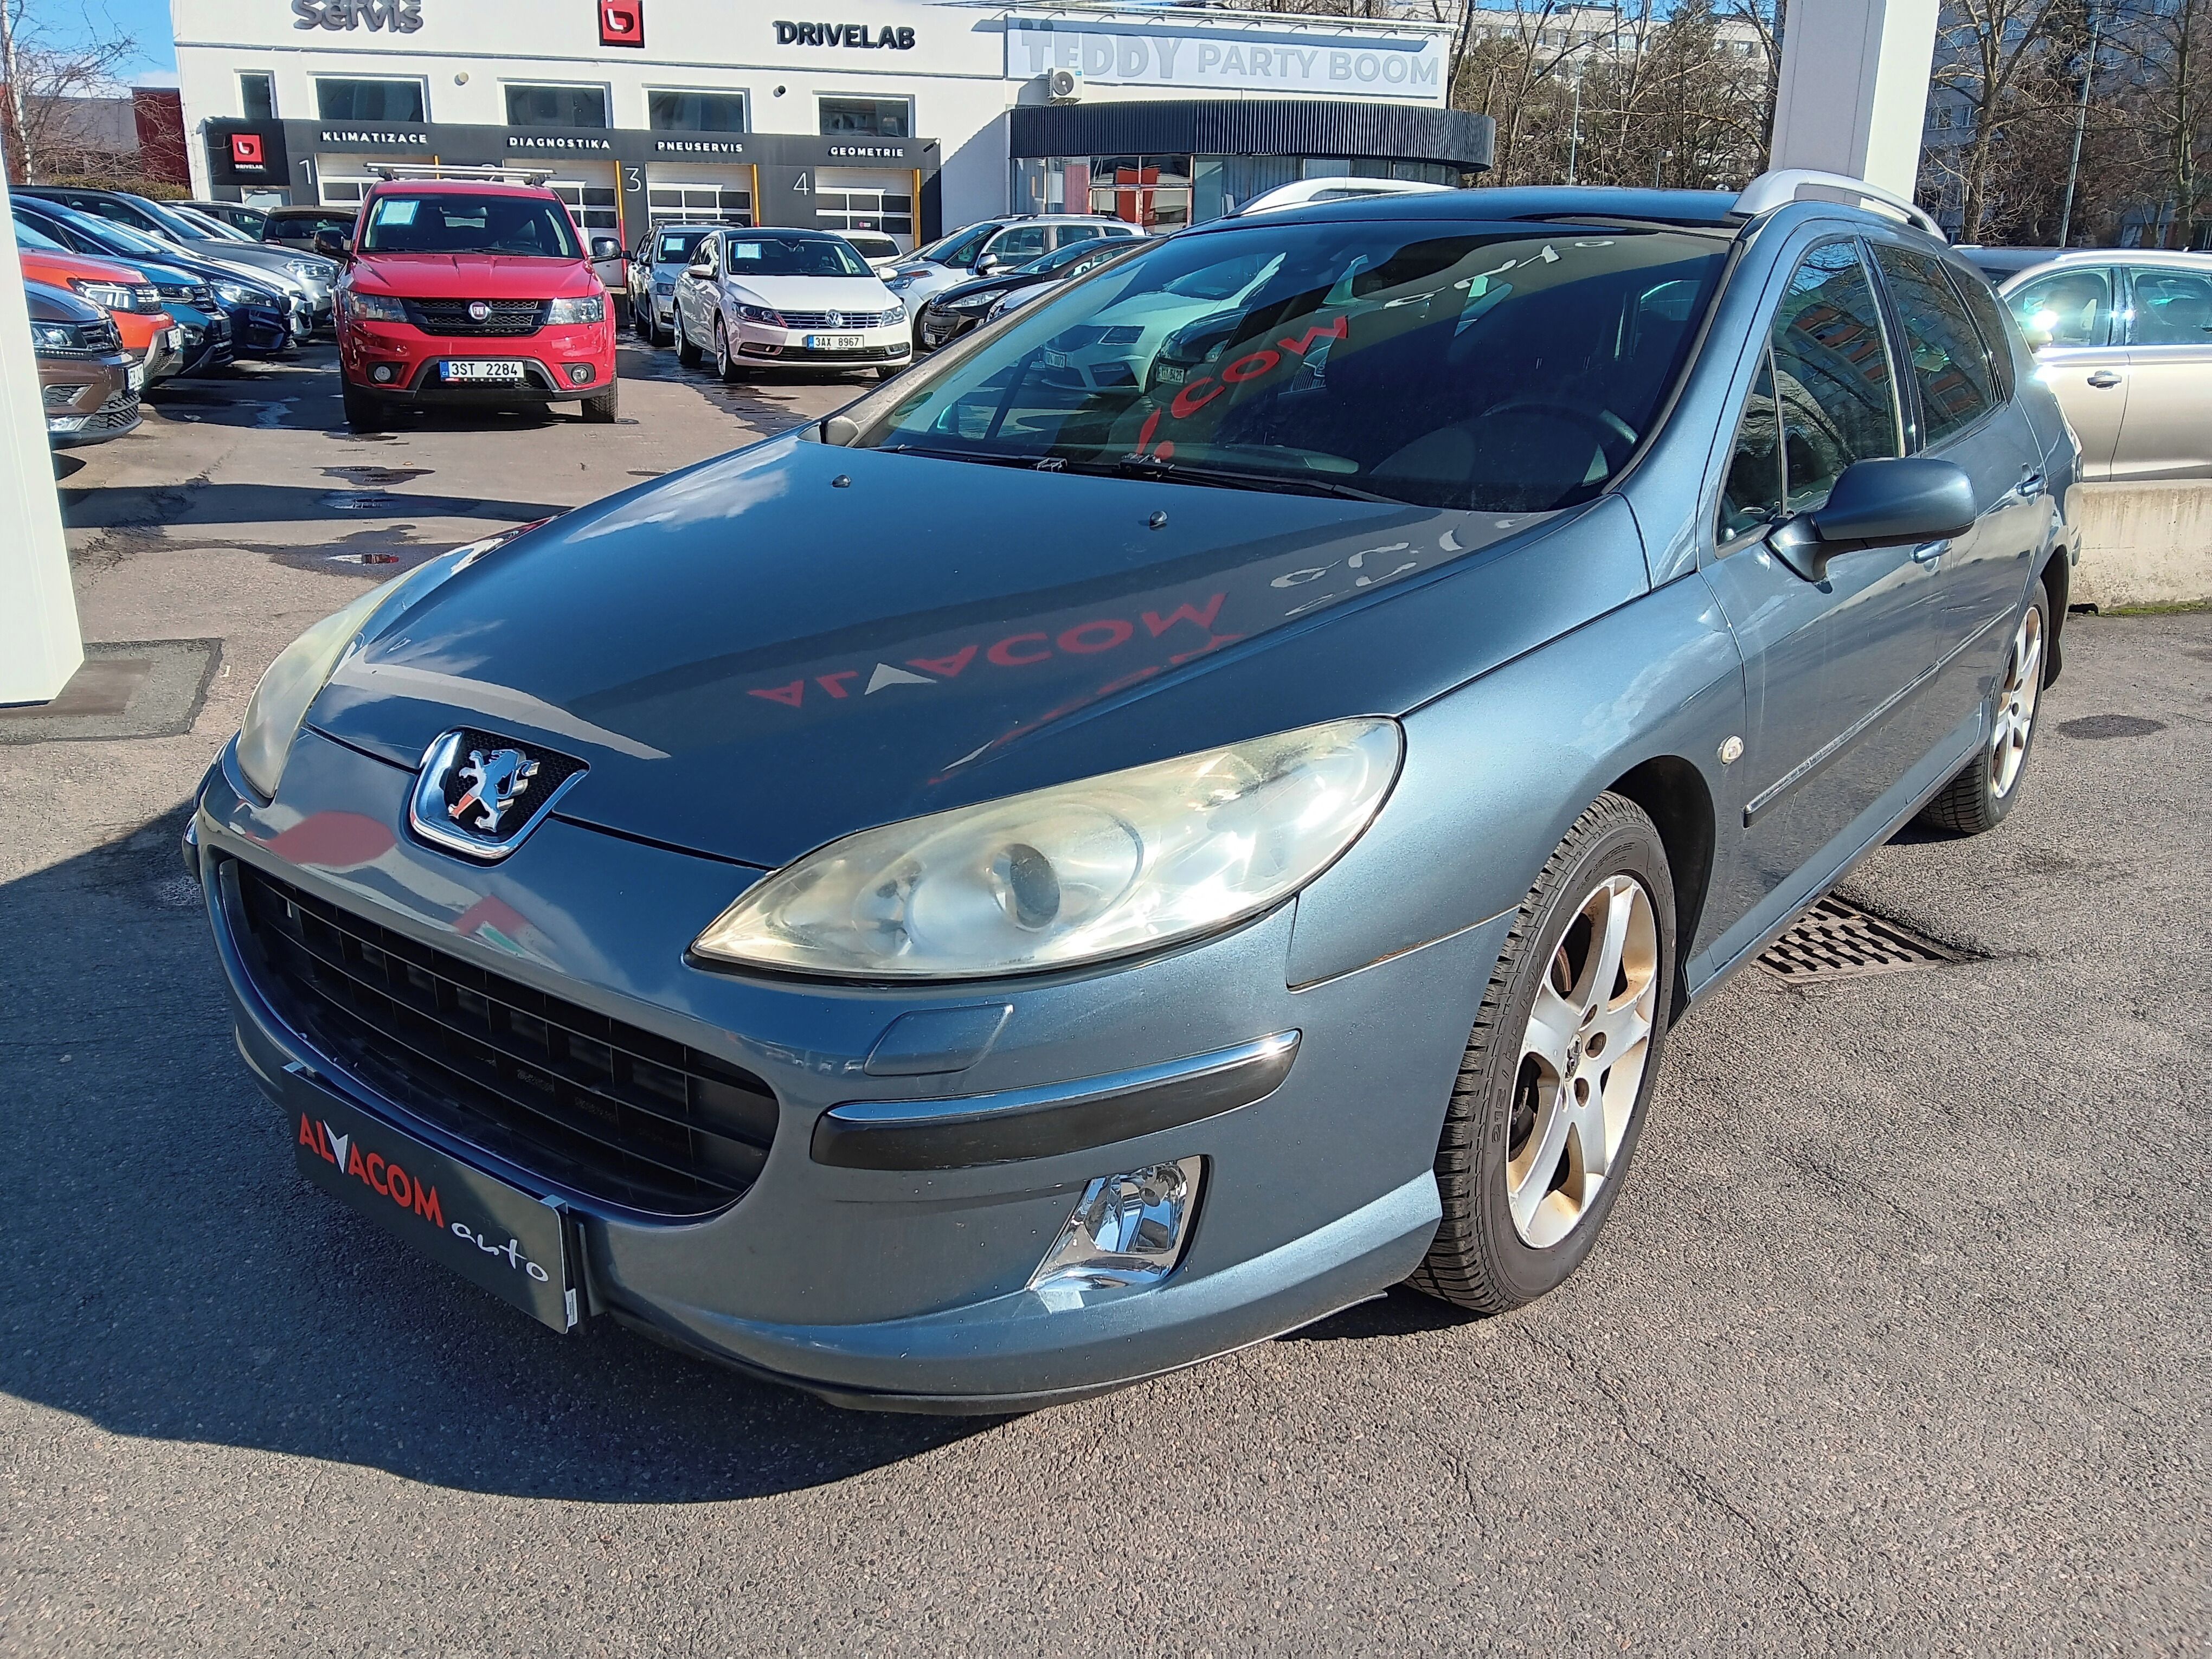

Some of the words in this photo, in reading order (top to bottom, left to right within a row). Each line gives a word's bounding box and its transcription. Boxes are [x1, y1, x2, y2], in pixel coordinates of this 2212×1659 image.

[772, 20, 915, 50] DRIVELAB
[1019, 25, 1182, 79] TEDDY
[1198, 43, 1319, 78] PARTY
[1329, 51, 1439, 85] BOOM
[321, 131, 427, 144] KLIMATIZACE
[509, 137, 610, 150] DIAGNOSTIKA
[657, 141, 744, 153] PNEUSERVIS
[830, 146, 904, 157] GEOMETRIE
[625, 168, 642, 192] 3
[793, 172, 810, 196] 4
[815, 337, 831, 346] 3AX
[838, 337, 859, 346] 8967
[452, 363, 475, 375] 3ST
[486, 363, 518, 376] 2284
[451, 1221, 549, 1282] auto
